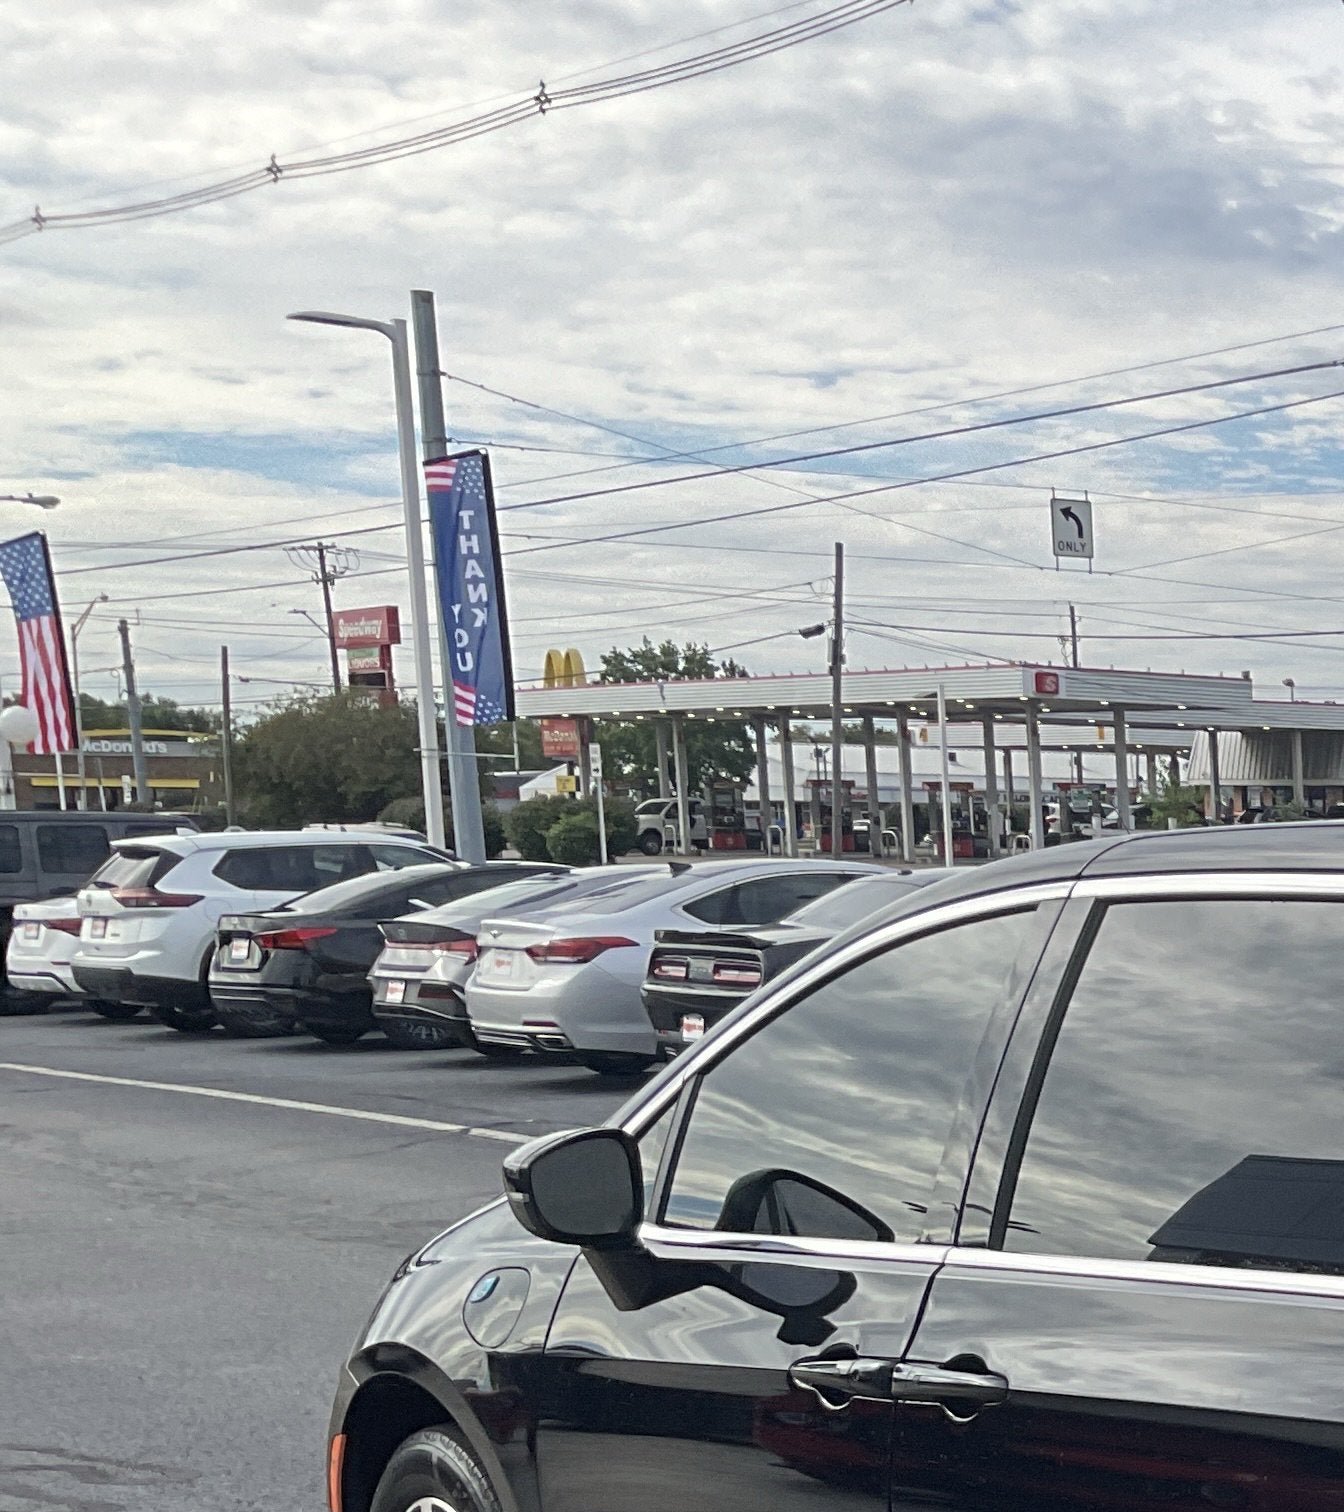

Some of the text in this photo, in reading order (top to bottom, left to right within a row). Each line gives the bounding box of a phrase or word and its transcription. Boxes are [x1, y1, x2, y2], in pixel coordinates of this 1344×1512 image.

[1058, 541, 1087, 552] ONLY
[338, 616, 382, 642] Speedway
[83, 740, 168, 753] McDonld's
